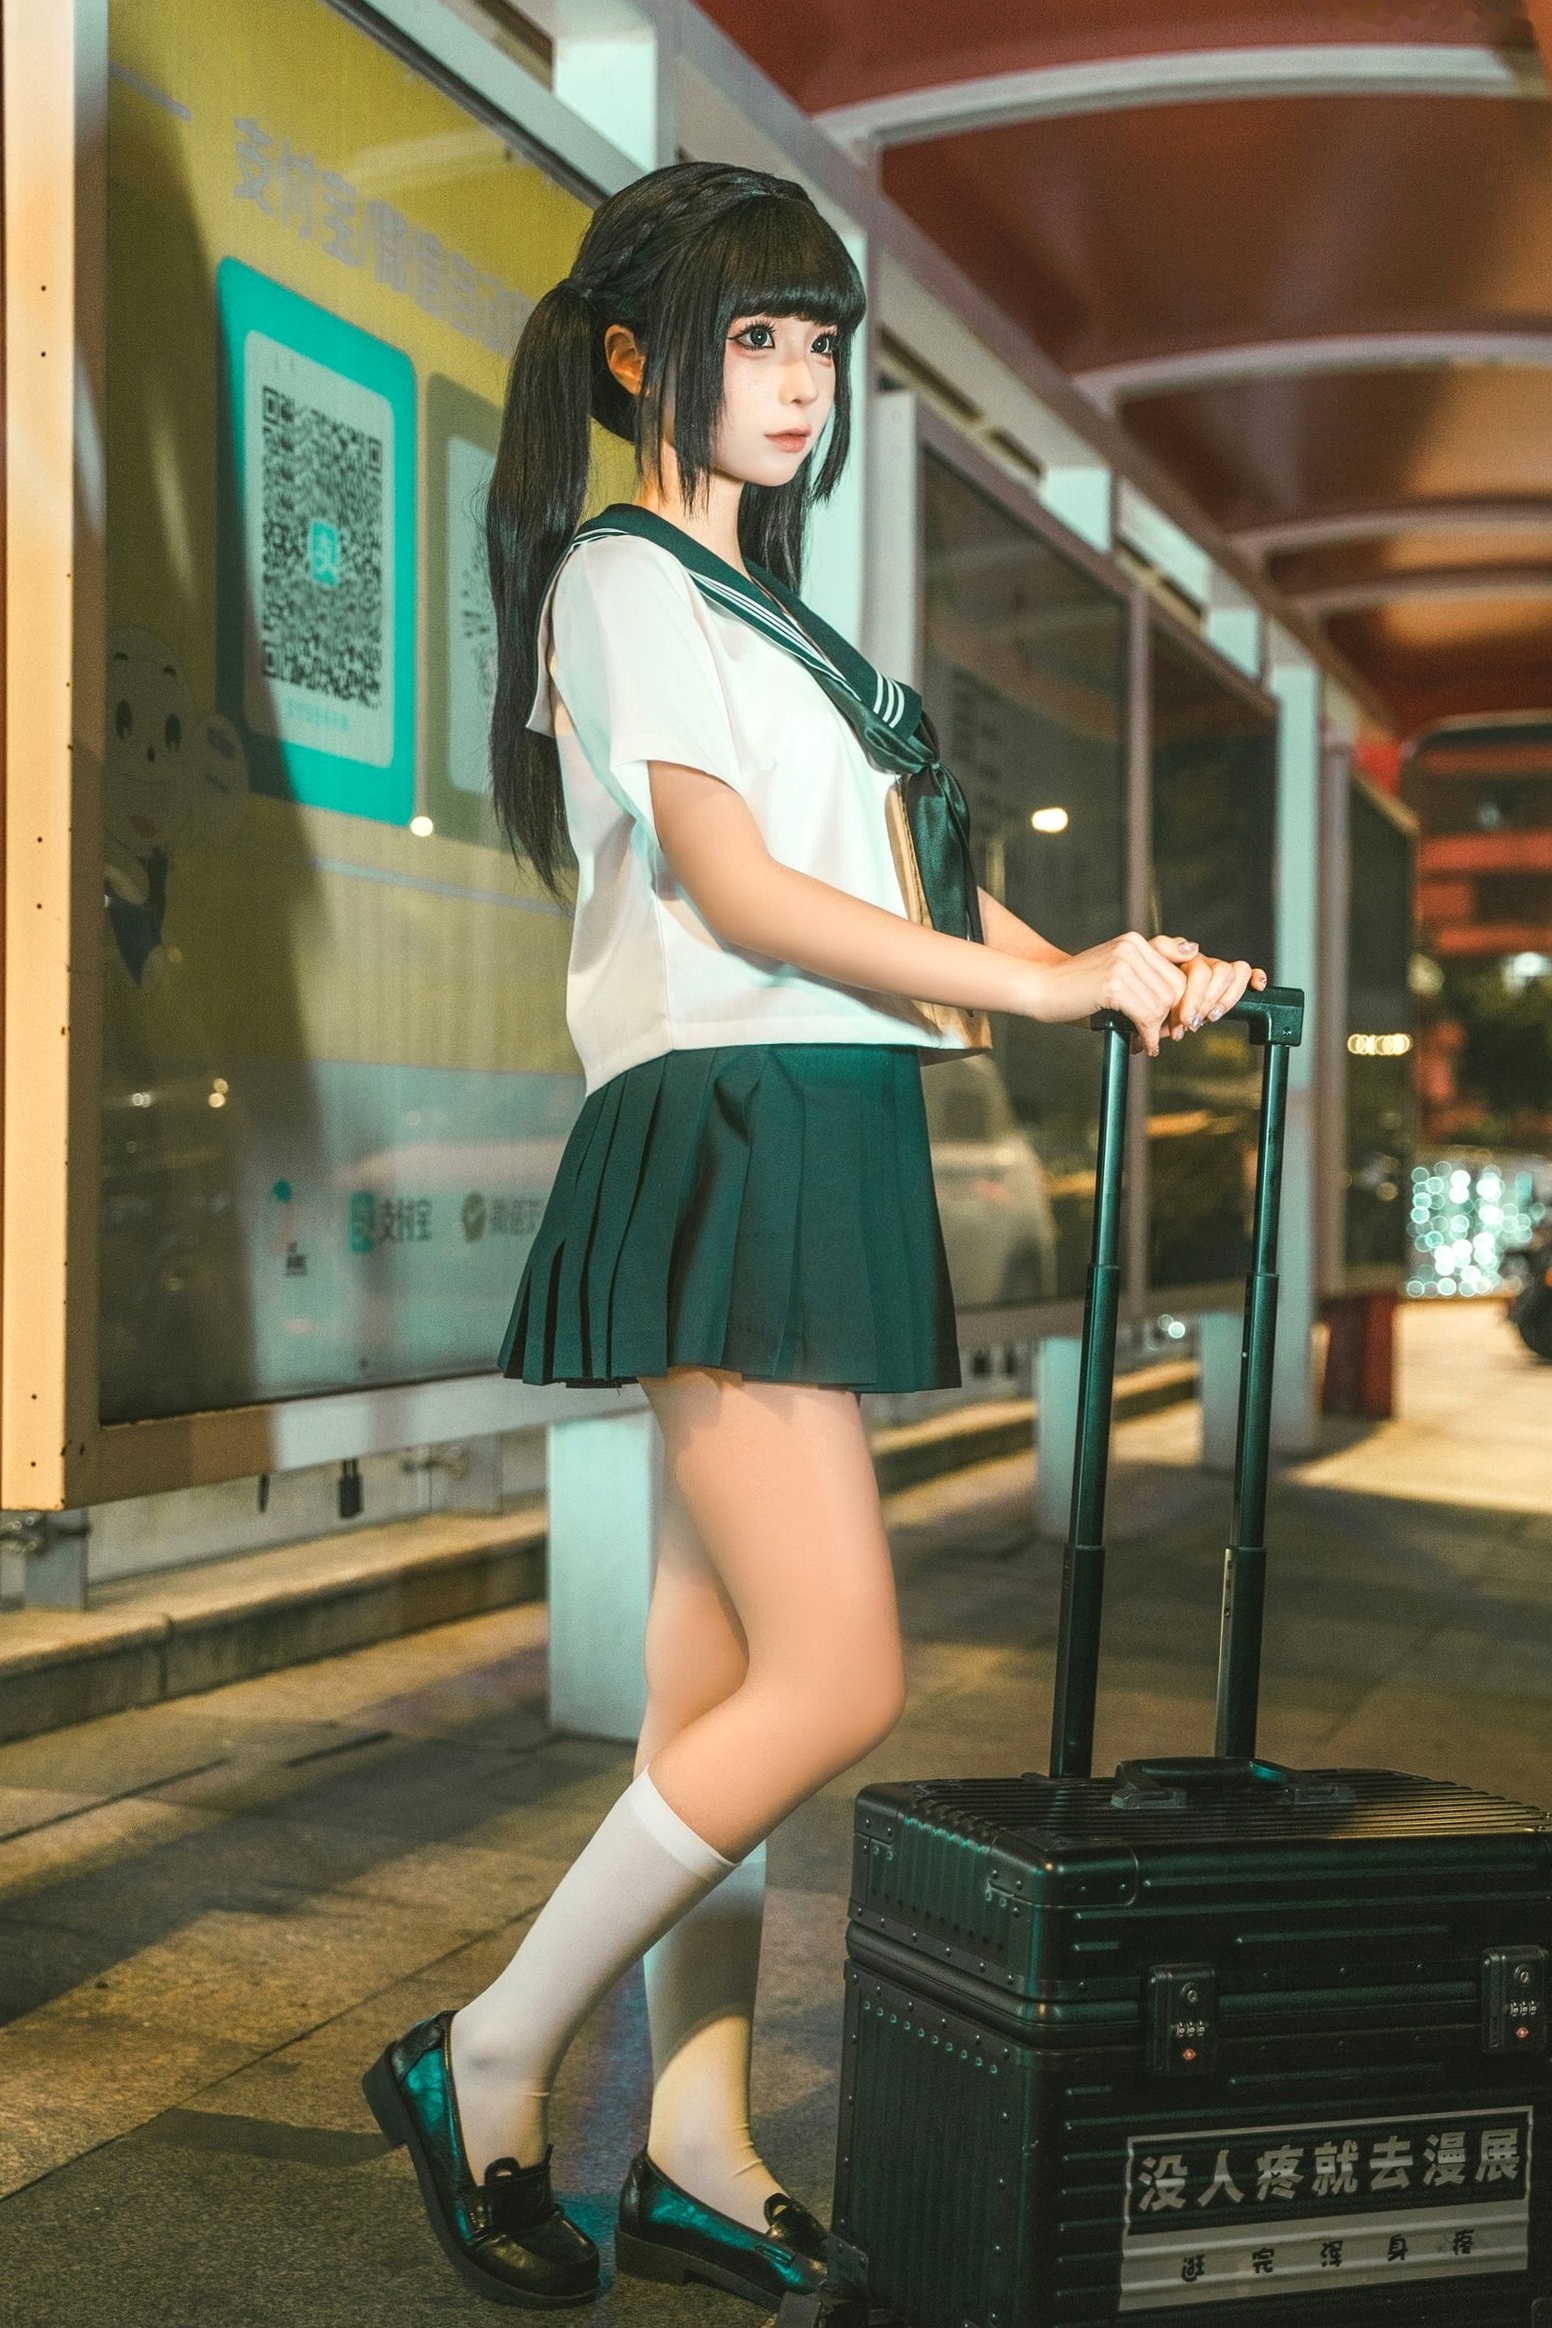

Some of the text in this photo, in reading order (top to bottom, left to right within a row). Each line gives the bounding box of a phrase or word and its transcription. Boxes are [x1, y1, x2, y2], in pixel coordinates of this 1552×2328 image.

[1138, 2127, 1521, 2212] 没人疼就去漫展
[1180, 2227, 1475, 2283] 逛完浑身疼
